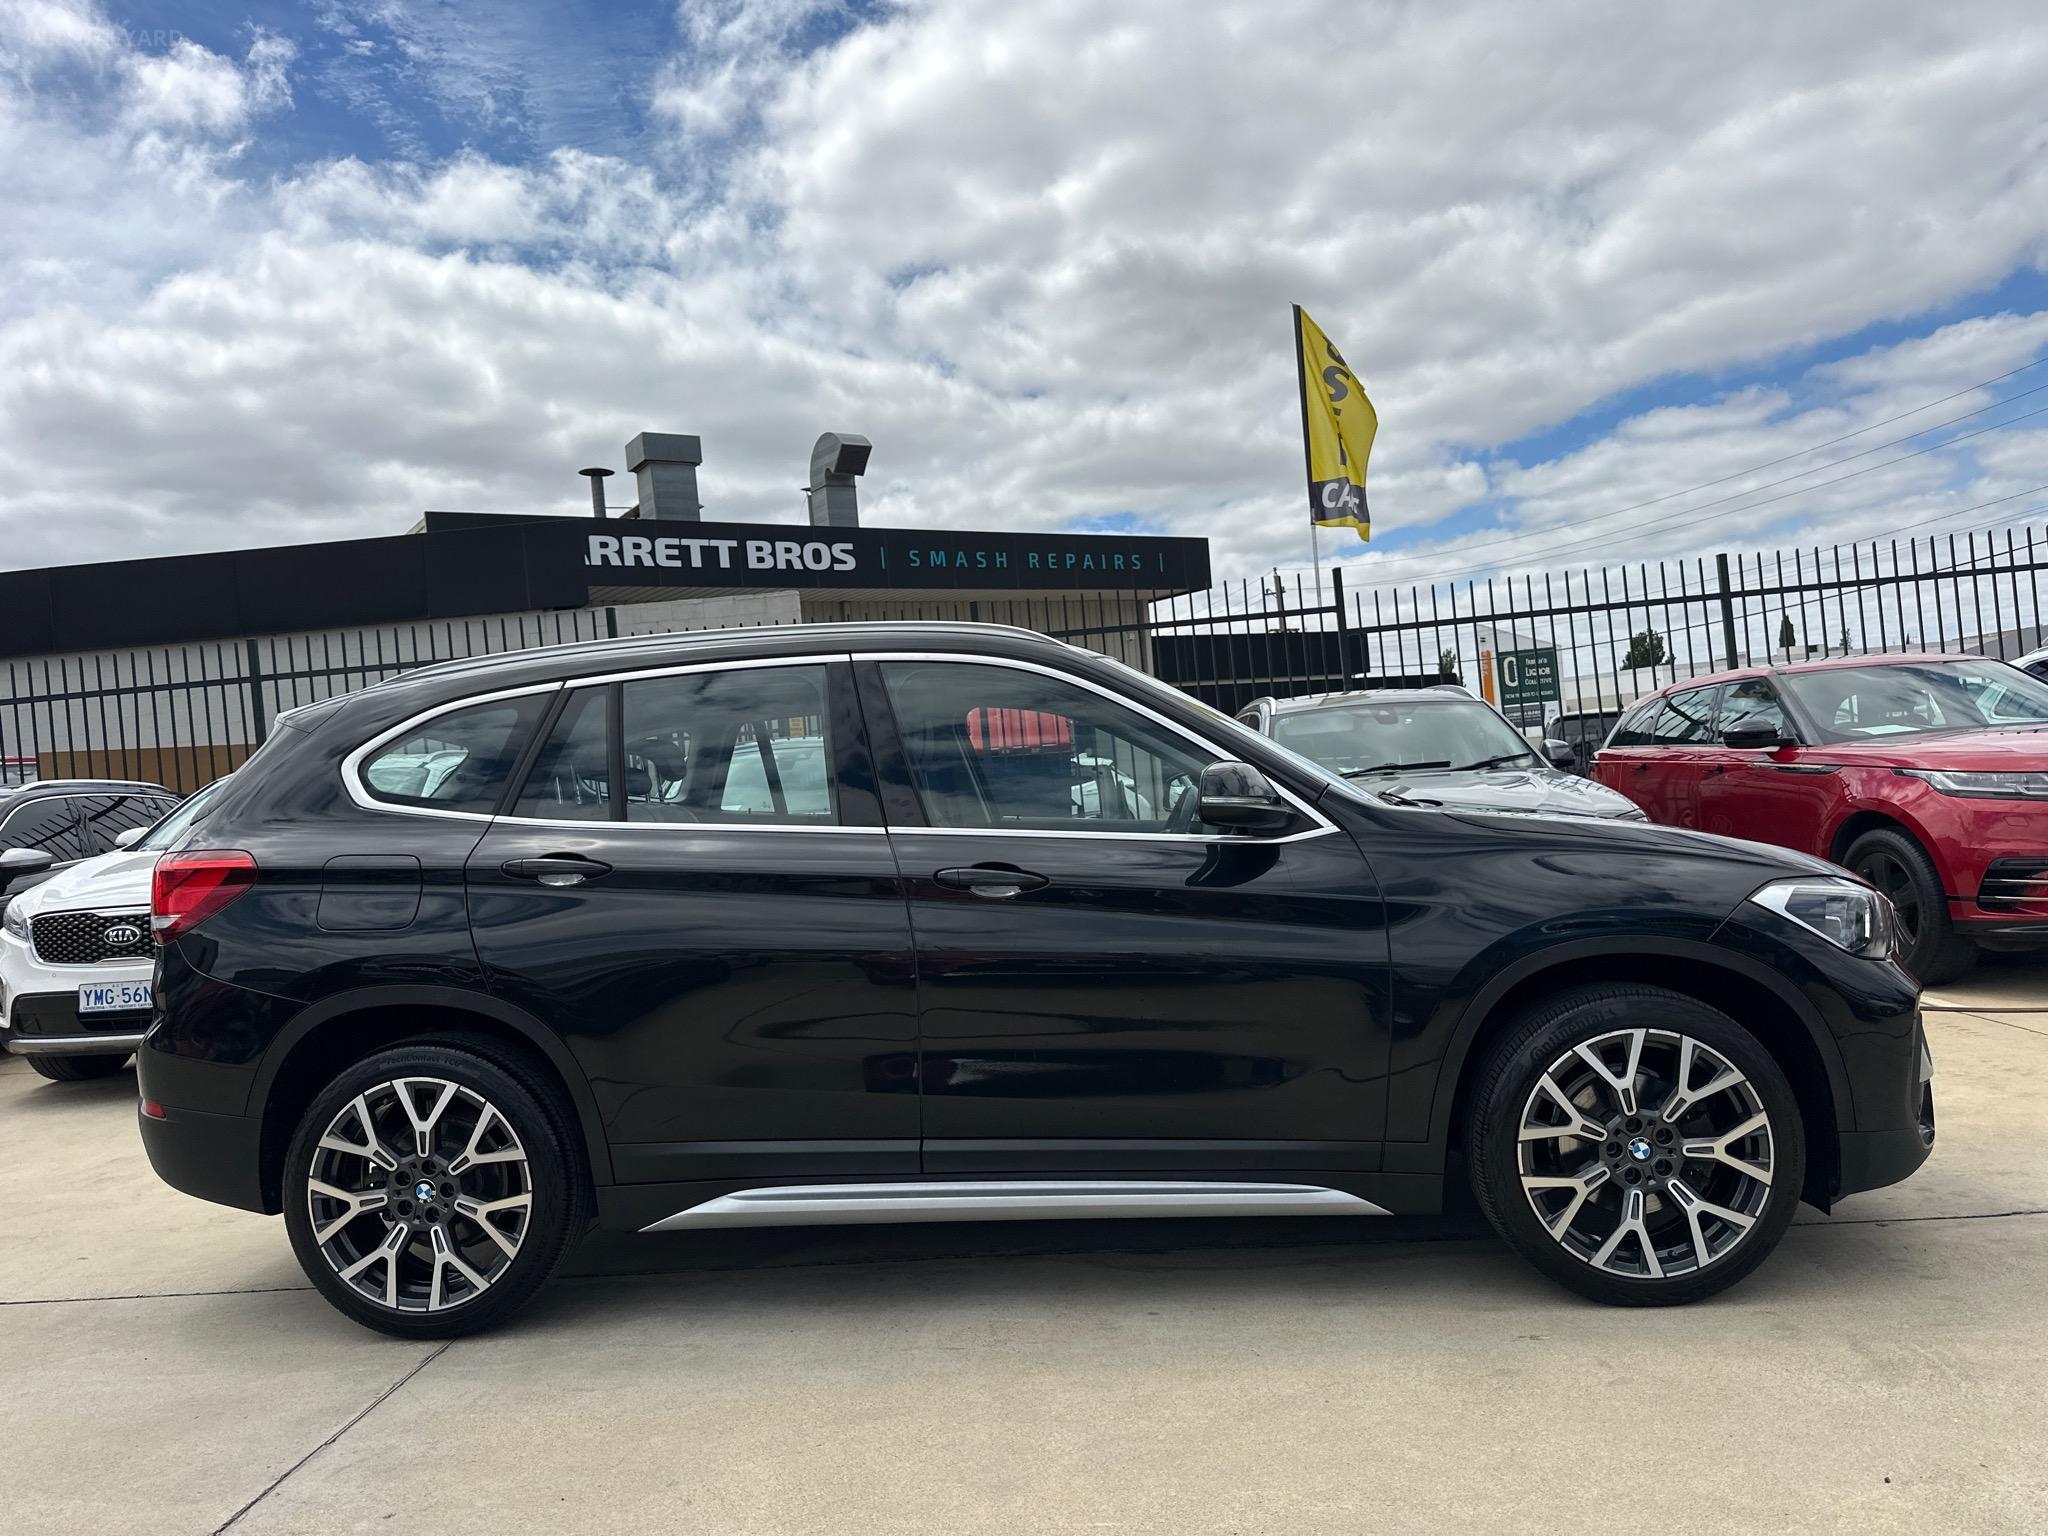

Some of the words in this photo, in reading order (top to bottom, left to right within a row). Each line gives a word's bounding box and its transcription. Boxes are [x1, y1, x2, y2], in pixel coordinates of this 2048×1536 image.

[584, 535, 738, 569] RRETT
[746, 540, 857, 571] BROS
[909, 550, 1007, 568] SMASH
[1028, 552, 1142, 570] REPAIRS
[108, 930, 134, 942] KIA
